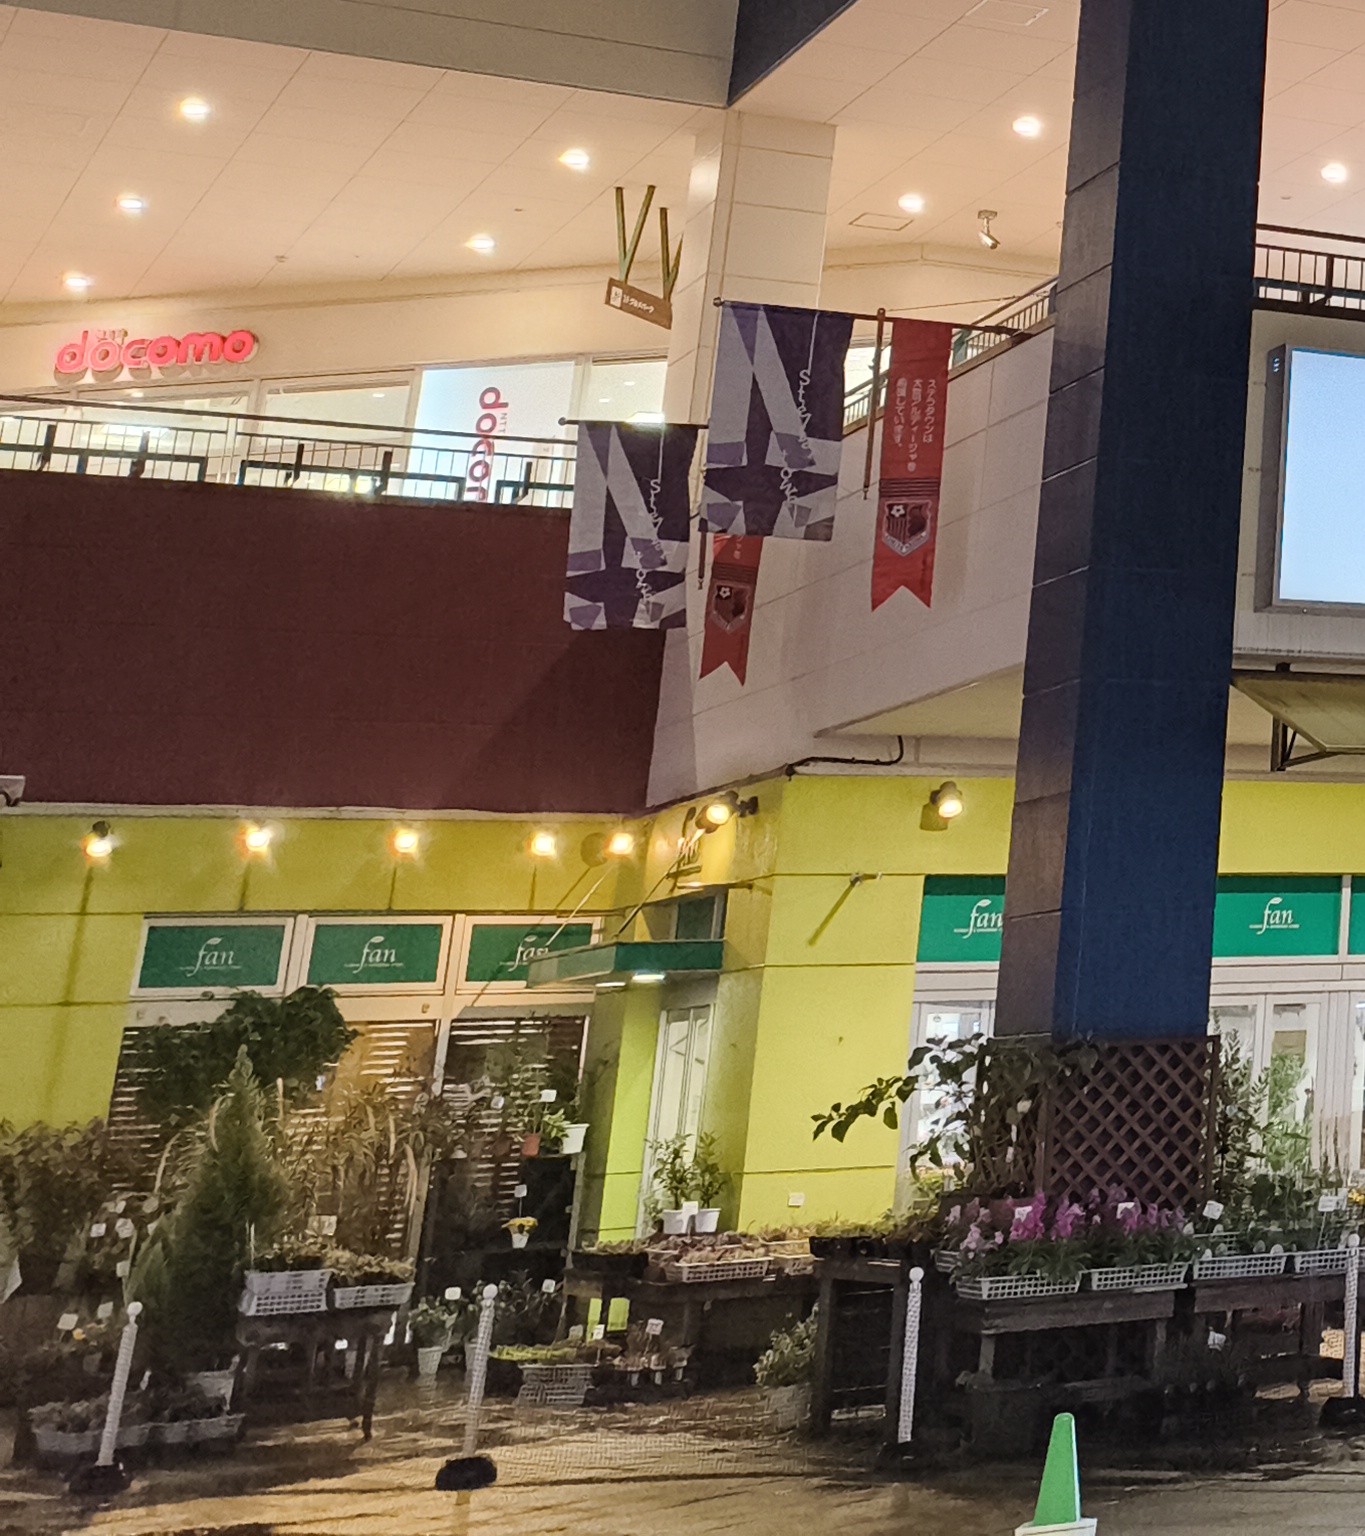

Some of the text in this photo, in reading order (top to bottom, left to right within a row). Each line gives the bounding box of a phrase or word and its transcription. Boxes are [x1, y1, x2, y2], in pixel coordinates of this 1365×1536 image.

[55, 330, 259, 374] docomo
[962, 899, 1004, 939] fan
[1256, 897, 1293, 935] fan
[186, 937, 234, 977] fan
[353, 935, 396, 974] fan
